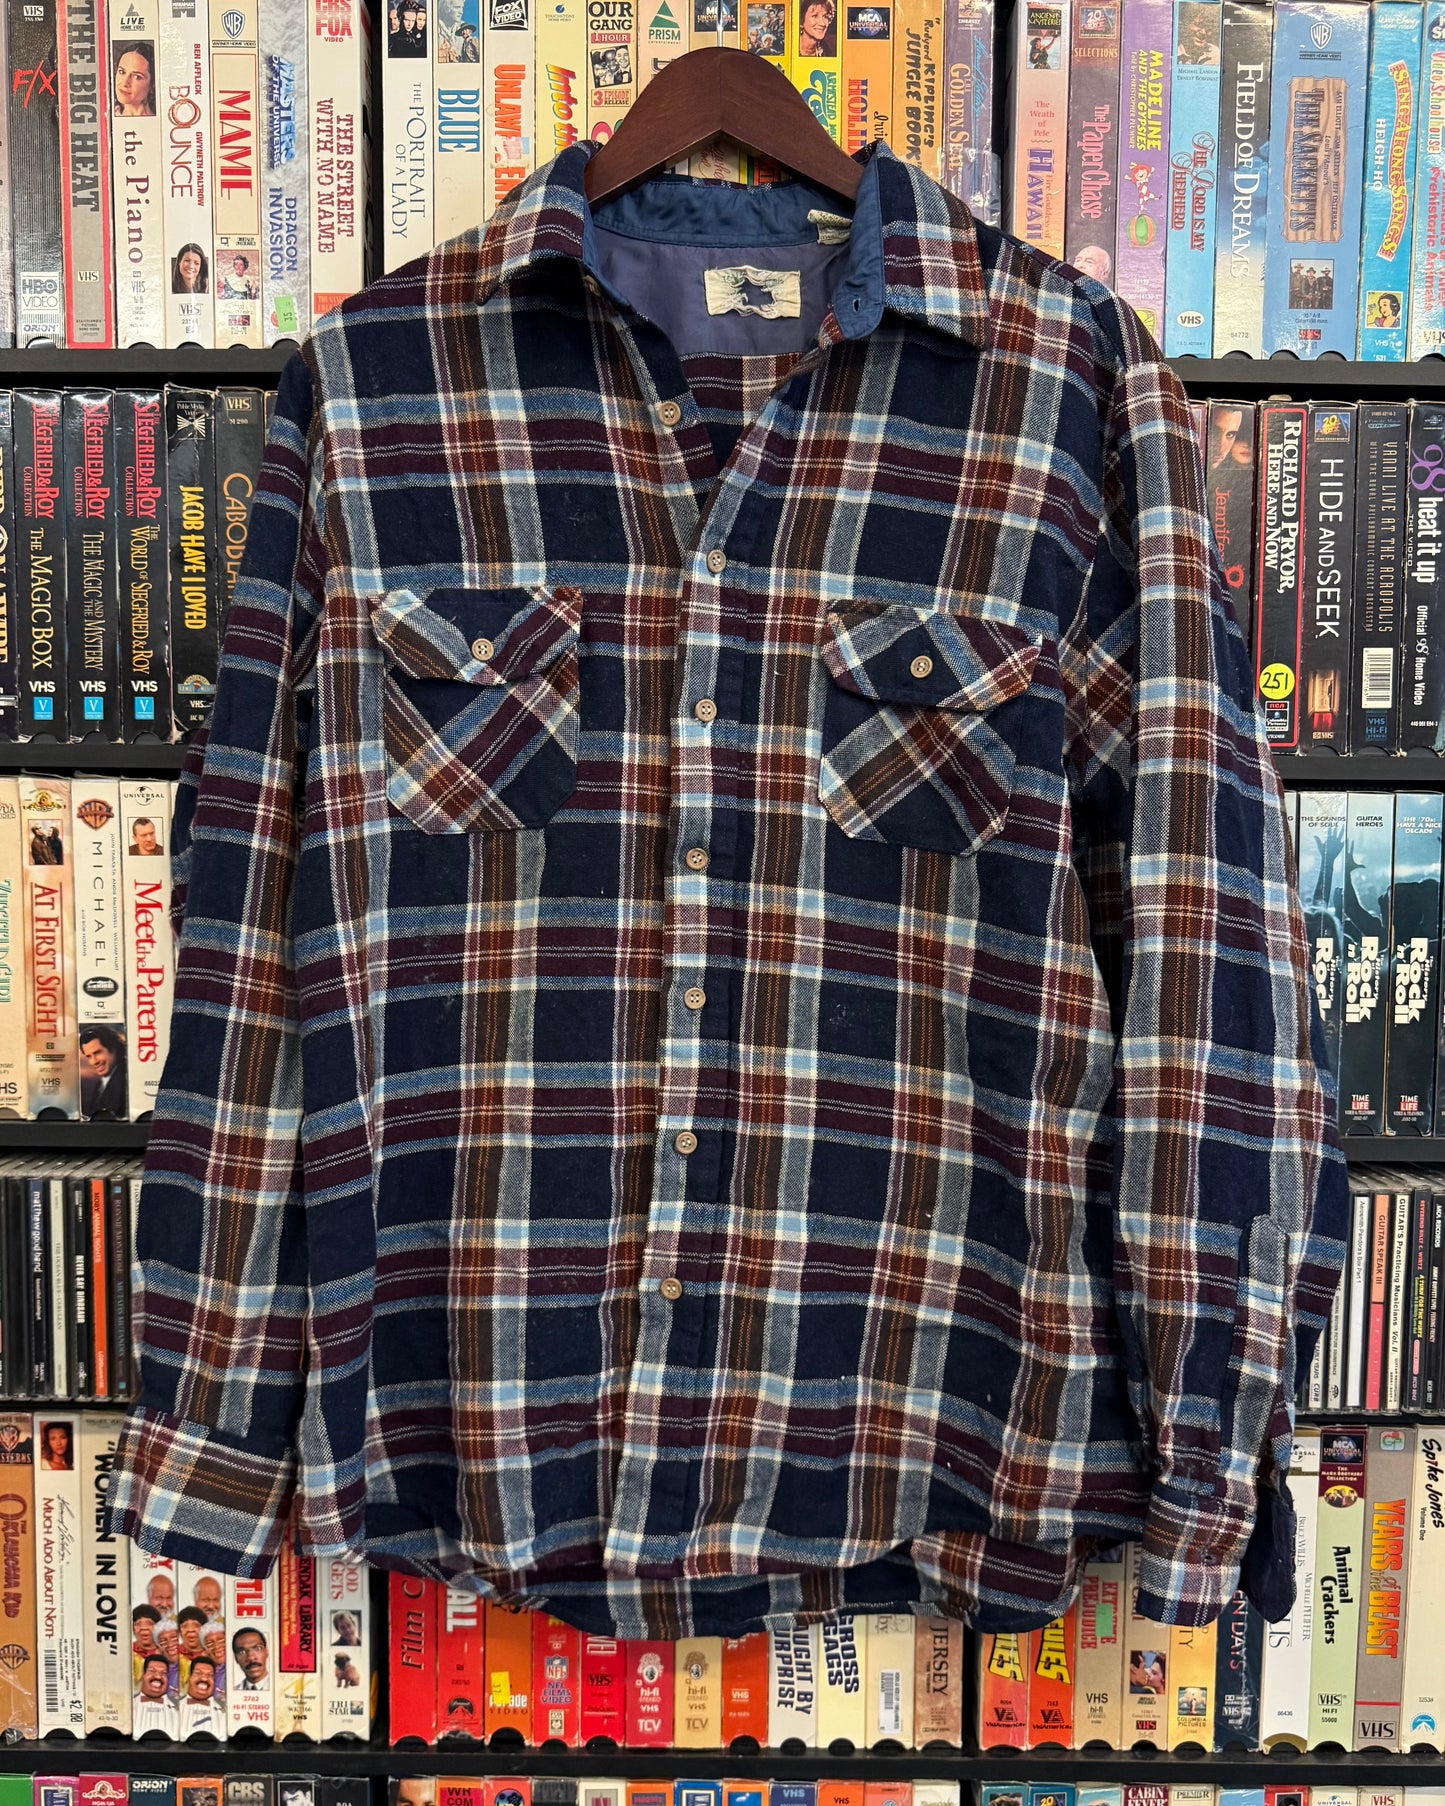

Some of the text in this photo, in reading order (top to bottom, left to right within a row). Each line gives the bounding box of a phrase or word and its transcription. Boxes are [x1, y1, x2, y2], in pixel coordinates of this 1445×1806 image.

[25, 6, 42, 15] VHS
[316, 16, 352, 36] FOX
[495, 1, 520, 15] FOX
[495, 13, 522, 24] VIDEO
[589, 1, 633, 17] OUR
[590, 20, 632, 30] GANG
[859, 13, 879, 21] MCA
[594, 32, 599, 41] 1
[649, 29, 680, 40] PRISM
[1075, 48, 1118, 57] SELECTIONS
[13, 60, 56, 108] F/X
[1137, 49, 1147, 151] AND THE GYPSIES
[1147, 50, 1164, 151] MADELINE
[68, 5, 99, 212] THE BIG HEAT
[279, 57, 295, 164] MASTERS
[438, 88, 480, 152] BLUE
[168, 85, 201, 198] BOUNCE
[218, 90, 252, 200] MAME
[407, 82, 427, 218] THE PORTRAIT
[1374, 118, 1387, 191] HEIGH-HO
[317, 98, 335, 253] WITH NO NAME
[337, 114, 354, 237] THE STREET
[391, 144, 408, 239] OF A LADY
[1230, 62, 1264, 279] FIELD OF DREAMS
[125, 131, 149, 263] the Piano
[1027, 148, 1054, 239] HAWAII
[269, 187, 283, 280] INVASION
[285, 197, 297, 271] DRAGON
[23, 279, 57, 294] HBO
[23, 296, 58, 307] VIDEO
[1382, 441, 1398, 478] YANNI
[24, 466, 33, 517] COLLECTION
[180, 485, 204, 530] JACOB
[1265, 443, 1283, 570] HERE AND NOW
[1277, 420, 1302, 594] RICHARD PRYOR,
[1381, 485, 1396, 511] LIVE
[1381, 518, 1396, 532] AT
[1411, 497, 1443, 583] heat it up
[181, 535, 205, 573] HAVE
[1315, 459, 1344, 639] HIDE AND SEEK
[1380, 538, 1395, 560] THE
[30, 528, 53, 669] THE MAGIC BOX
[82, 531, 105, 670] THE MAGIC AND THE MYSTERY
[181, 586, 207, 630] LOVED
[1378, 567, 1394, 632] ACROPOLIS
[80, 681, 106, 692] VHS
[1263, 672, 1289, 690] 251
[34, 883, 58, 910] AT
[92, 841, 105, 967] MICHAEL
[35, 916, 59, 969] FIRST
[134, 880, 165, 1063] Meet the Parents
[36, 975, 61, 1037] SIGHT
[42, 1078, 61, 1086] VHS
[1352, 1102, 1369, 1110] LIFE
[32, 1191, 43, 1273] matthew good band
[1398, 1198, 1406, 1237] GUITAR'S
[1395, 1238, 1404, 1282] Practicing
[75, 1255, 86, 1324] NEVER SAY DINOSAUR
[1392, 1283, 1402, 1327] Musicians
[1422, 1438, 1445, 1528] Spike Jones
[43, 1497, 54, 1535] MUCH
[43, 1539, 55, 1564] ADO
[44, 1567, 55, 1604] ABOUT
[331, 1561, 344, 1600] GETS
[1333, 1546, 1353, 1603] Animal
[1366, 1498, 1406, 1658] YEARS of the BEAST
[1081, 1576, 1099, 1649] PREJUDICE
[1320, 1575, 1339, 1644] Crackers
[401, 1611, 425, 1670] Film
[930, 1626, 949, 1697] JERSEY
[541, 1696, 572, 1704] VIDEO
[547, 1682, 564, 1690] NFL
[641, 1687, 659, 1697] hi-fi
[70, 1700, 83, 1723] $2.00
[638, 1719, 661, 1732] TCV
[1136, 1721, 1156, 1729] VHS
[1361, 1722, 1394, 1738] VHS
[132, 1780, 169, 1789] ORION
[227, 1782, 265, 1800] CBS
[1128, 1787, 1164, 1799] CABIN
